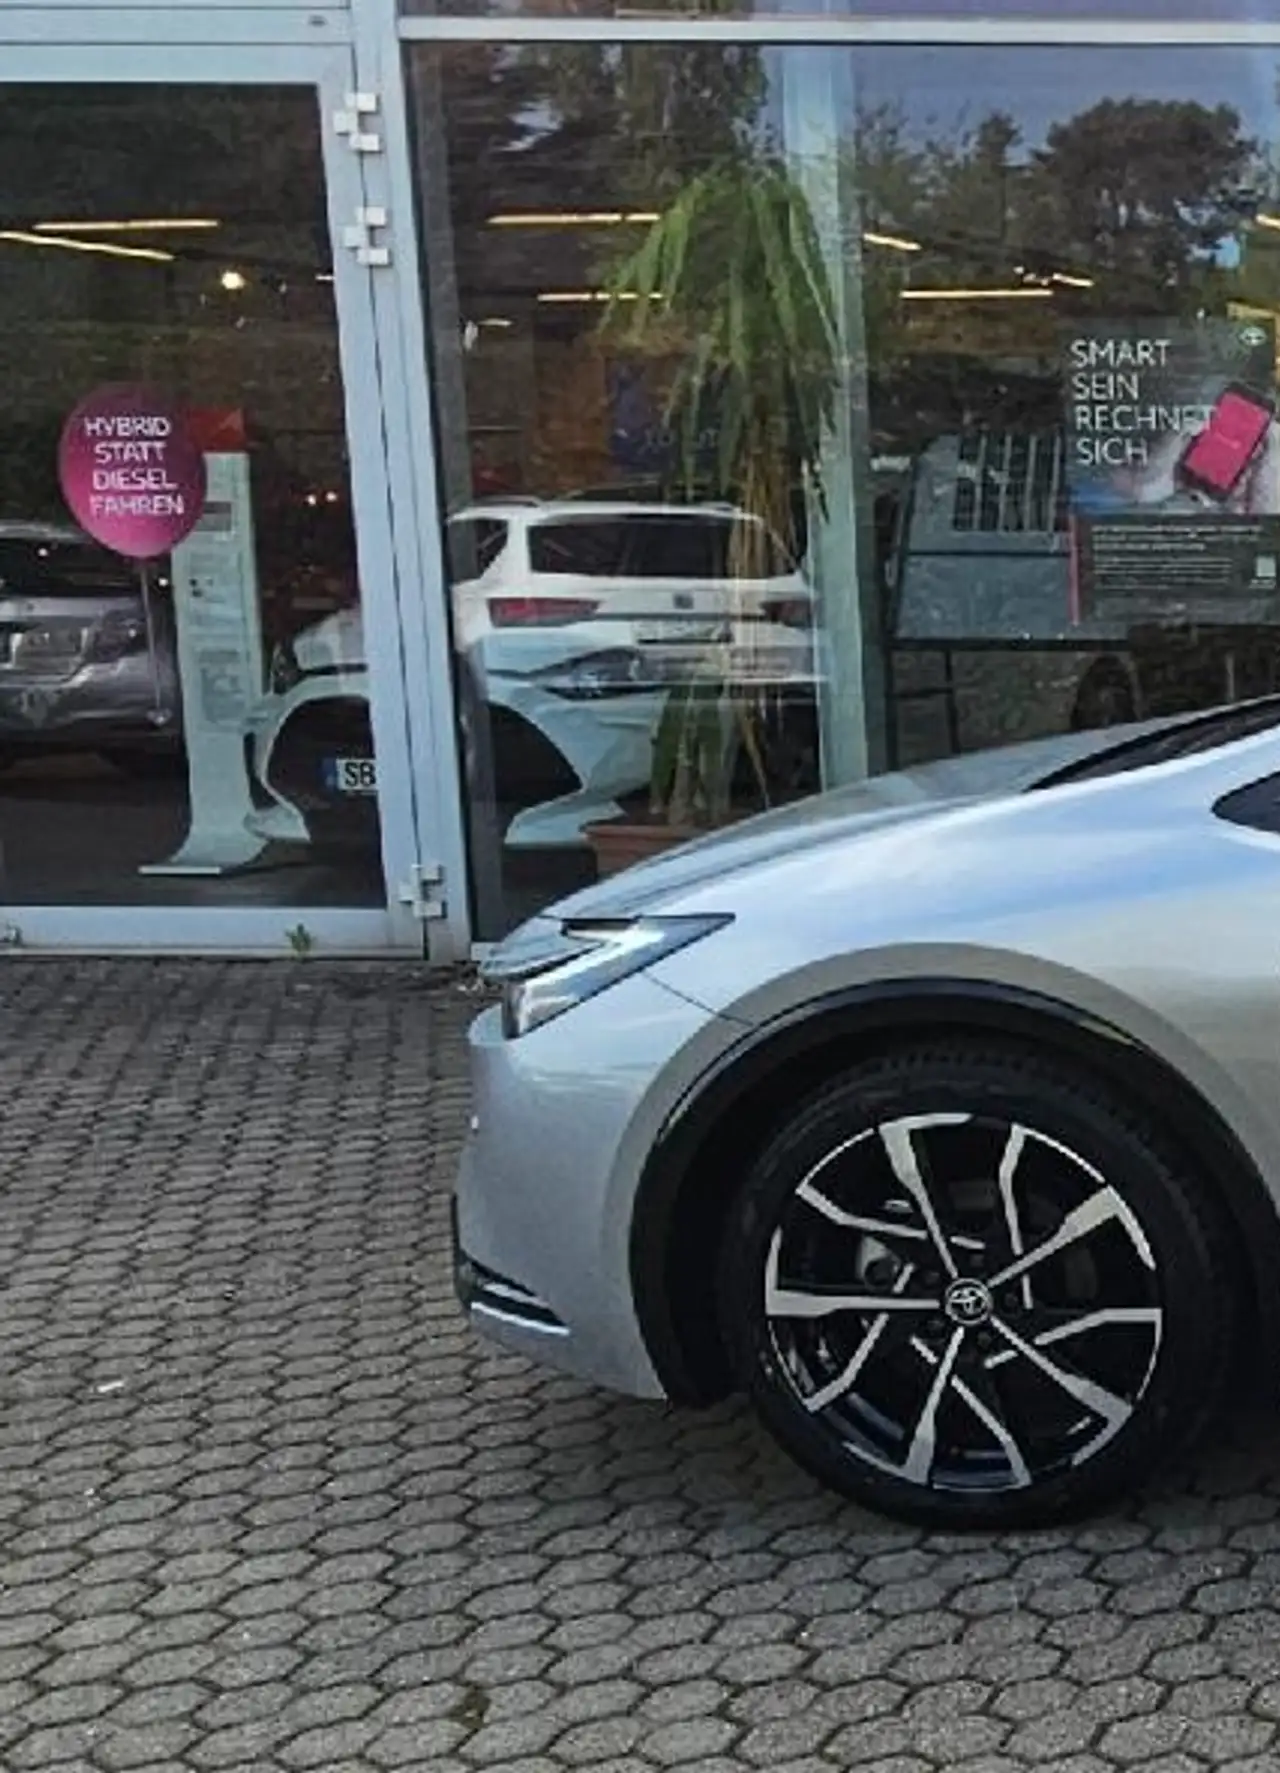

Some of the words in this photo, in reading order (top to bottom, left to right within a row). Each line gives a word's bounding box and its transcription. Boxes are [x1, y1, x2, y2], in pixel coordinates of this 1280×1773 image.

[1070, 338, 1171, 368] SMART
[1072, 372, 1140, 401] SEIN
[84, 416, 171, 437] HYBRID
[1075, 404, 1217, 431] RECHNET
[94, 440, 167, 464] STATT
[1076, 437, 1148, 466] SICH
[92, 467, 178, 491] DIESEL
[89, 493, 185, 516] FAHREN
[345, 762, 376, 787] SB
